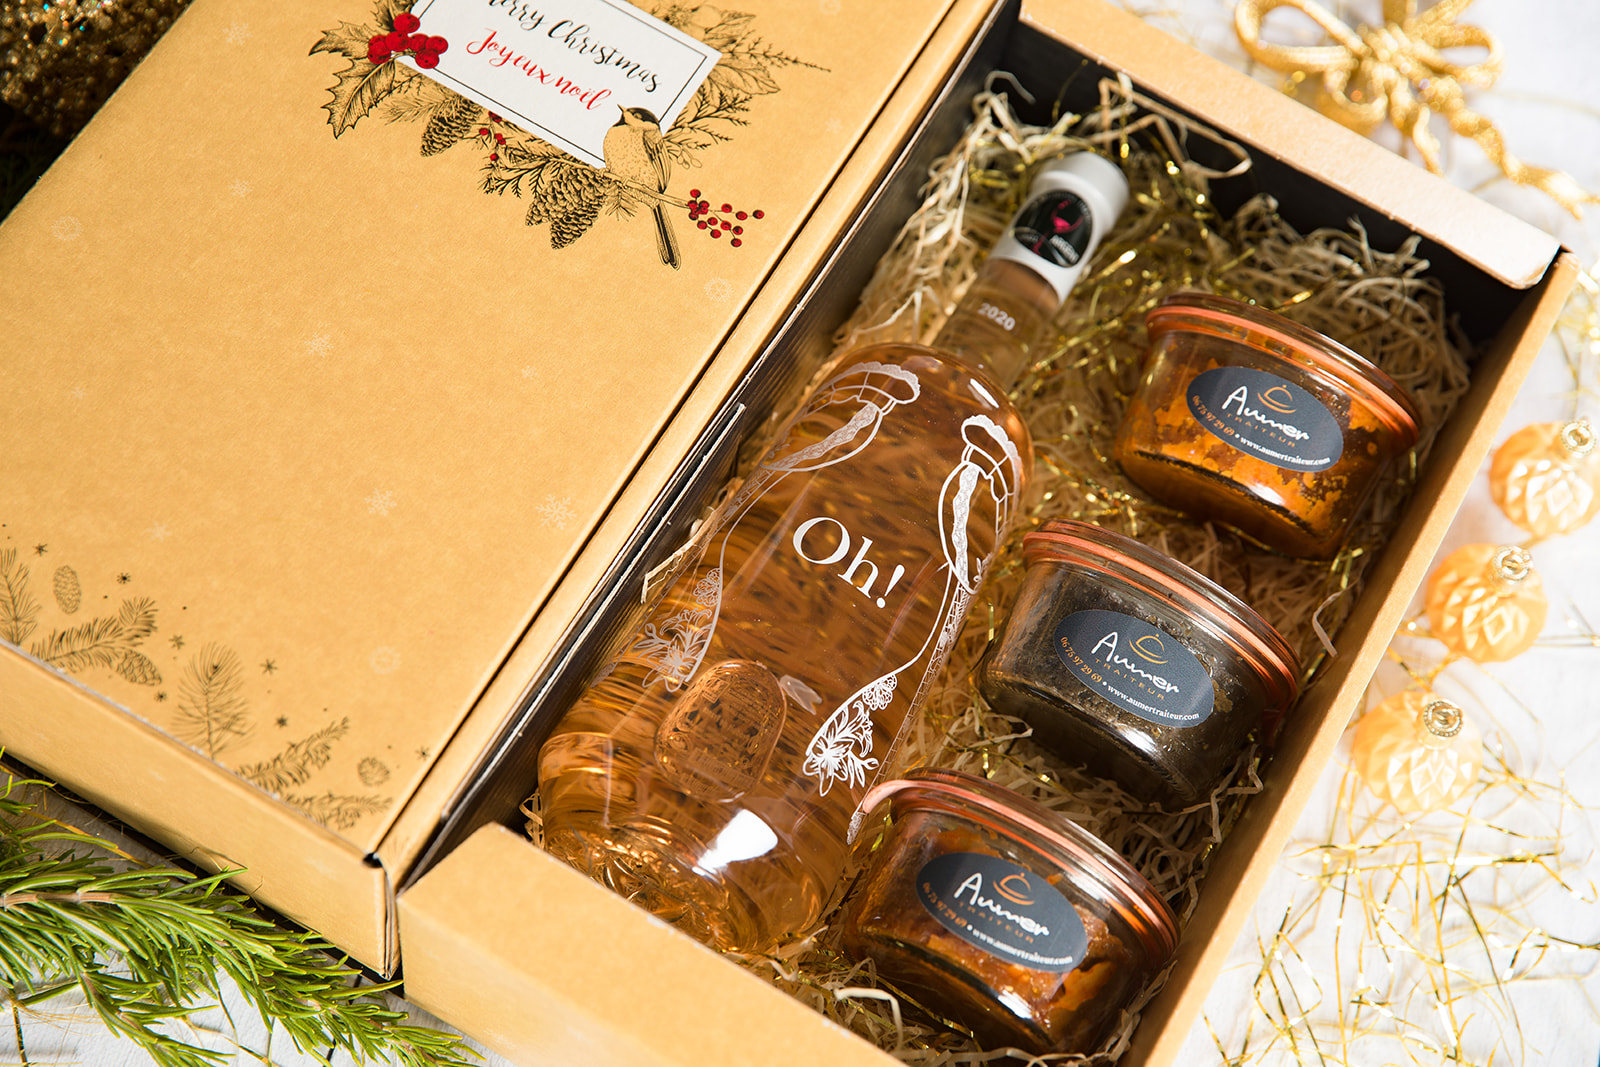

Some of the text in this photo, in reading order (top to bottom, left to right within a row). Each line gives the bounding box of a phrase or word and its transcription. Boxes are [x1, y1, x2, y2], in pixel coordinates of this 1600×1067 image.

[466, 27, 612, 110] Joyeux noël
[548, 20, 662, 93] Christmas
[977, 302, 1016, 331] 2020
[1221, 385, 1310, 441] Aumer
[1227, 413, 1297, 448] TRAITEUR
[1240, 436, 1331, 466] www.aumertraiteur.com
[793, 517, 905, 608] Oh!
[1060, 636, 1200, 721] 06 75 97 29 69 www.aumertraiteur.com
[1091, 631, 1180, 694] Aumer
[1095, 658, 1164, 700] TRAITEUR
[953, 872, 1050, 936] Aumer
